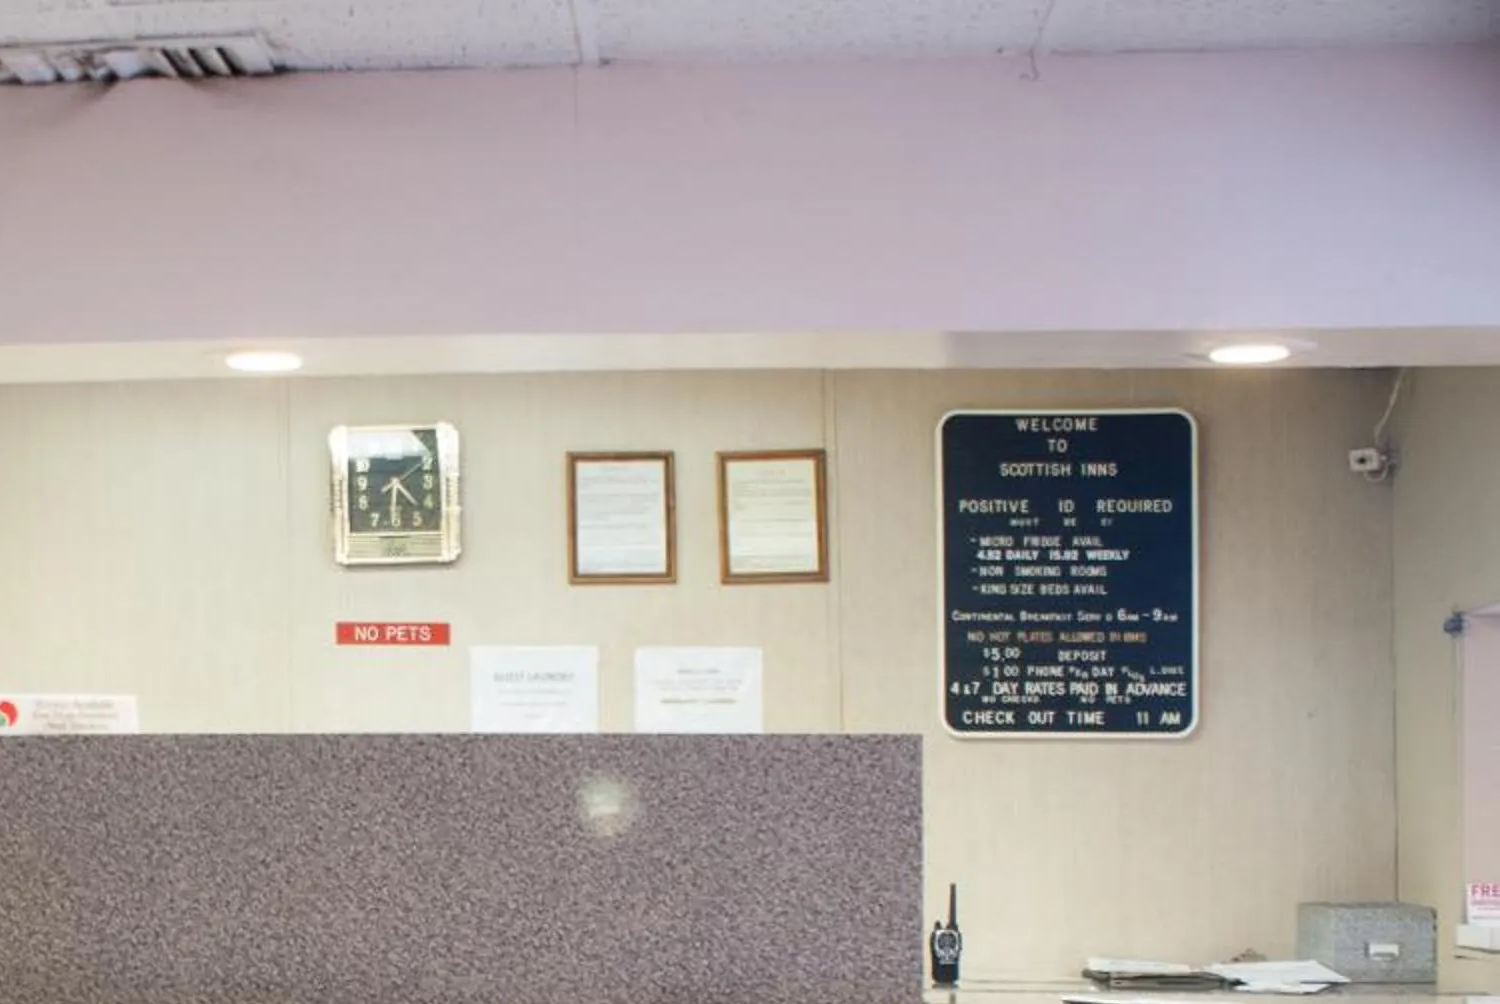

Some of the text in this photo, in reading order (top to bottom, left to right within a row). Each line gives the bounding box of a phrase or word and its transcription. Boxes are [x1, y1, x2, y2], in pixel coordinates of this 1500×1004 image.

[1015, 418, 1099, 432] WELCOME
[1047, 439, 1068, 452] TO
[999, 462, 1118, 477] SCOTTISH INNS
[959, 499, 1173, 513] POSITIVE ID REQUIRED
[1005, 549, 1040, 561] DAILY
[1086, 549, 1130, 561] WEEKLY
[1014, 566, 1061, 577] SMOKING
[1070, 566, 1108, 577] ROOMS
[1009, 584, 1034, 595] SIZE
[1040, 584, 1070, 595] BEDS
[1073, 584, 1108, 595] AVAIL
[354, 624, 431, 641] NO PETS
[1057, 650, 1107, 662] DEPOSIT
[1027, 665, 1064, 677] PHONE
[1091, 666, 1115, 677] DAY
[992, 681, 1019, 695] DAY
[1025, 681, 1066, 696] RATES
[1069, 681, 1099, 696] PAID
[1105, 682, 1119, 696] IN
[1125, 681, 1187, 697] ADVANCE
[962, 711, 1181, 725] CHECK OUT TIME 11 AM
